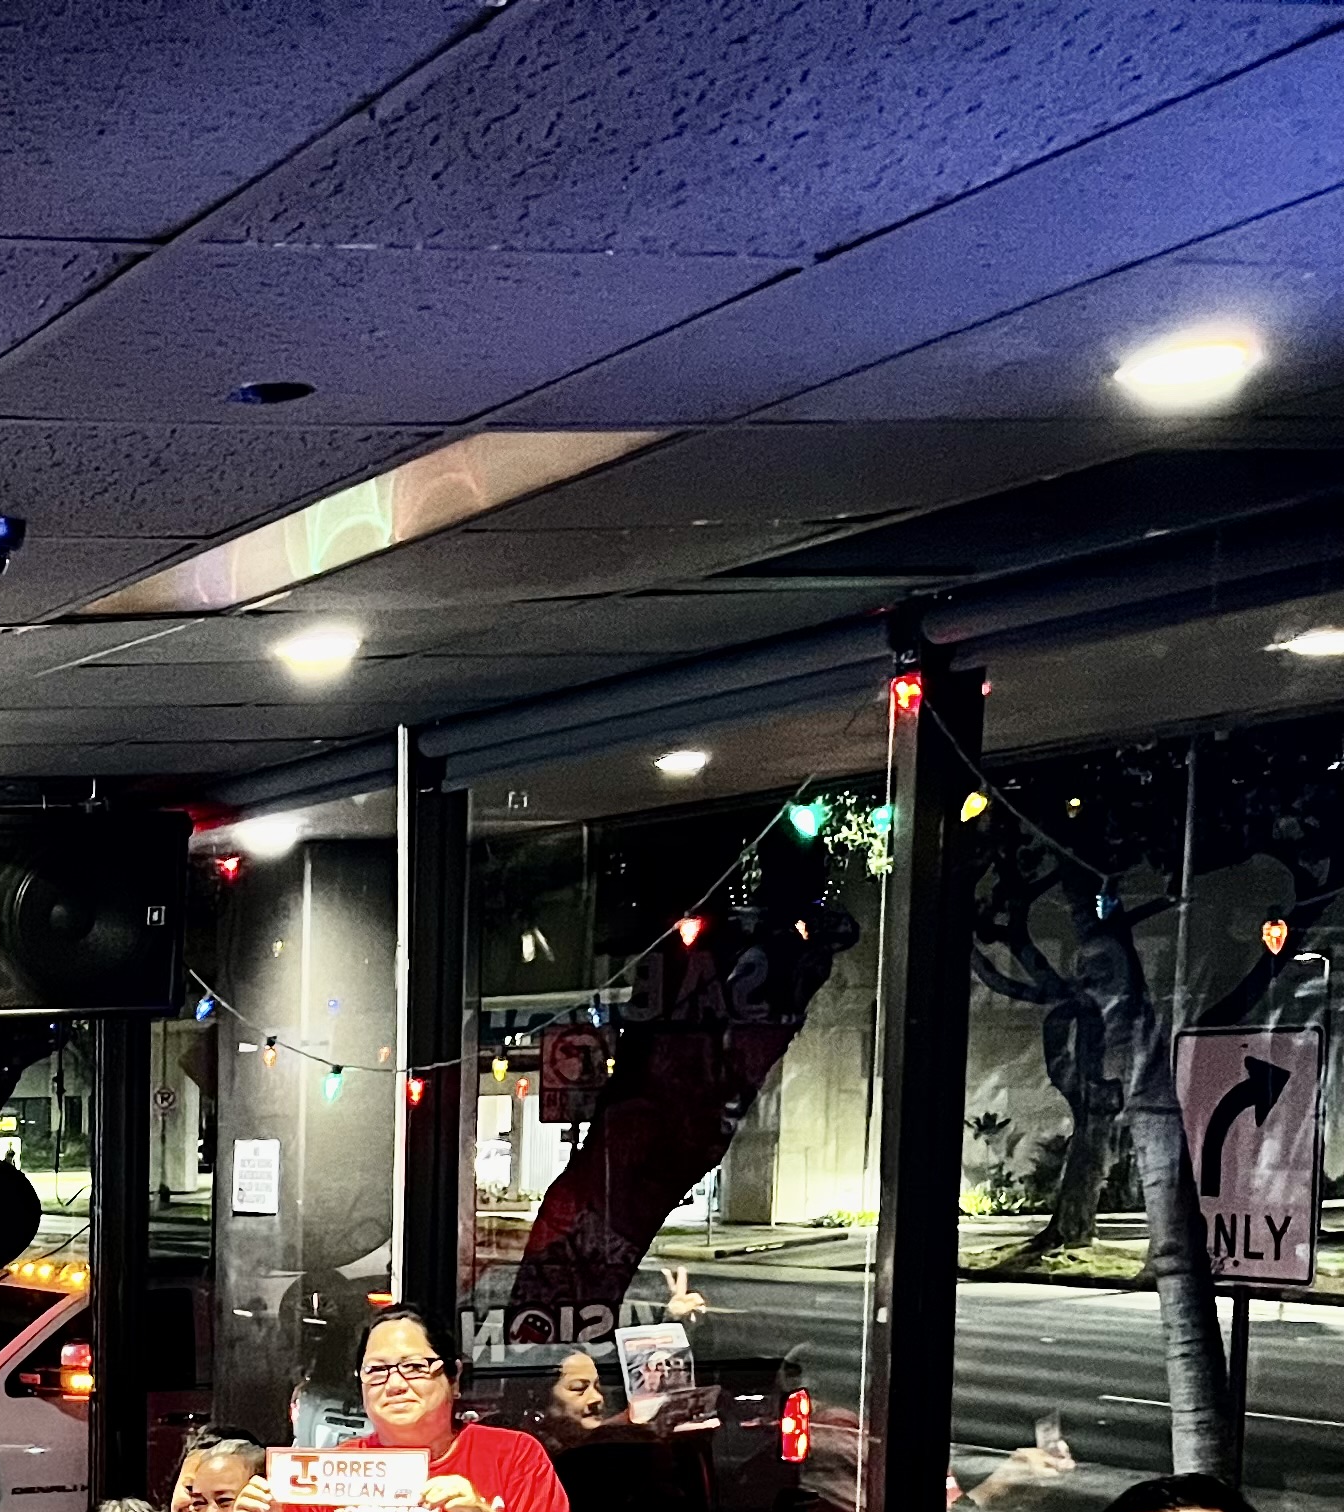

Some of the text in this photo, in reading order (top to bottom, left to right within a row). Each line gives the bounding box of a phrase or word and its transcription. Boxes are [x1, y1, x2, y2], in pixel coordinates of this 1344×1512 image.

[1213, 1213, 1292, 1260] NLY
[290, 1455, 387, 1479] TORRES
[289, 1475, 386, 1498] SABLAN
